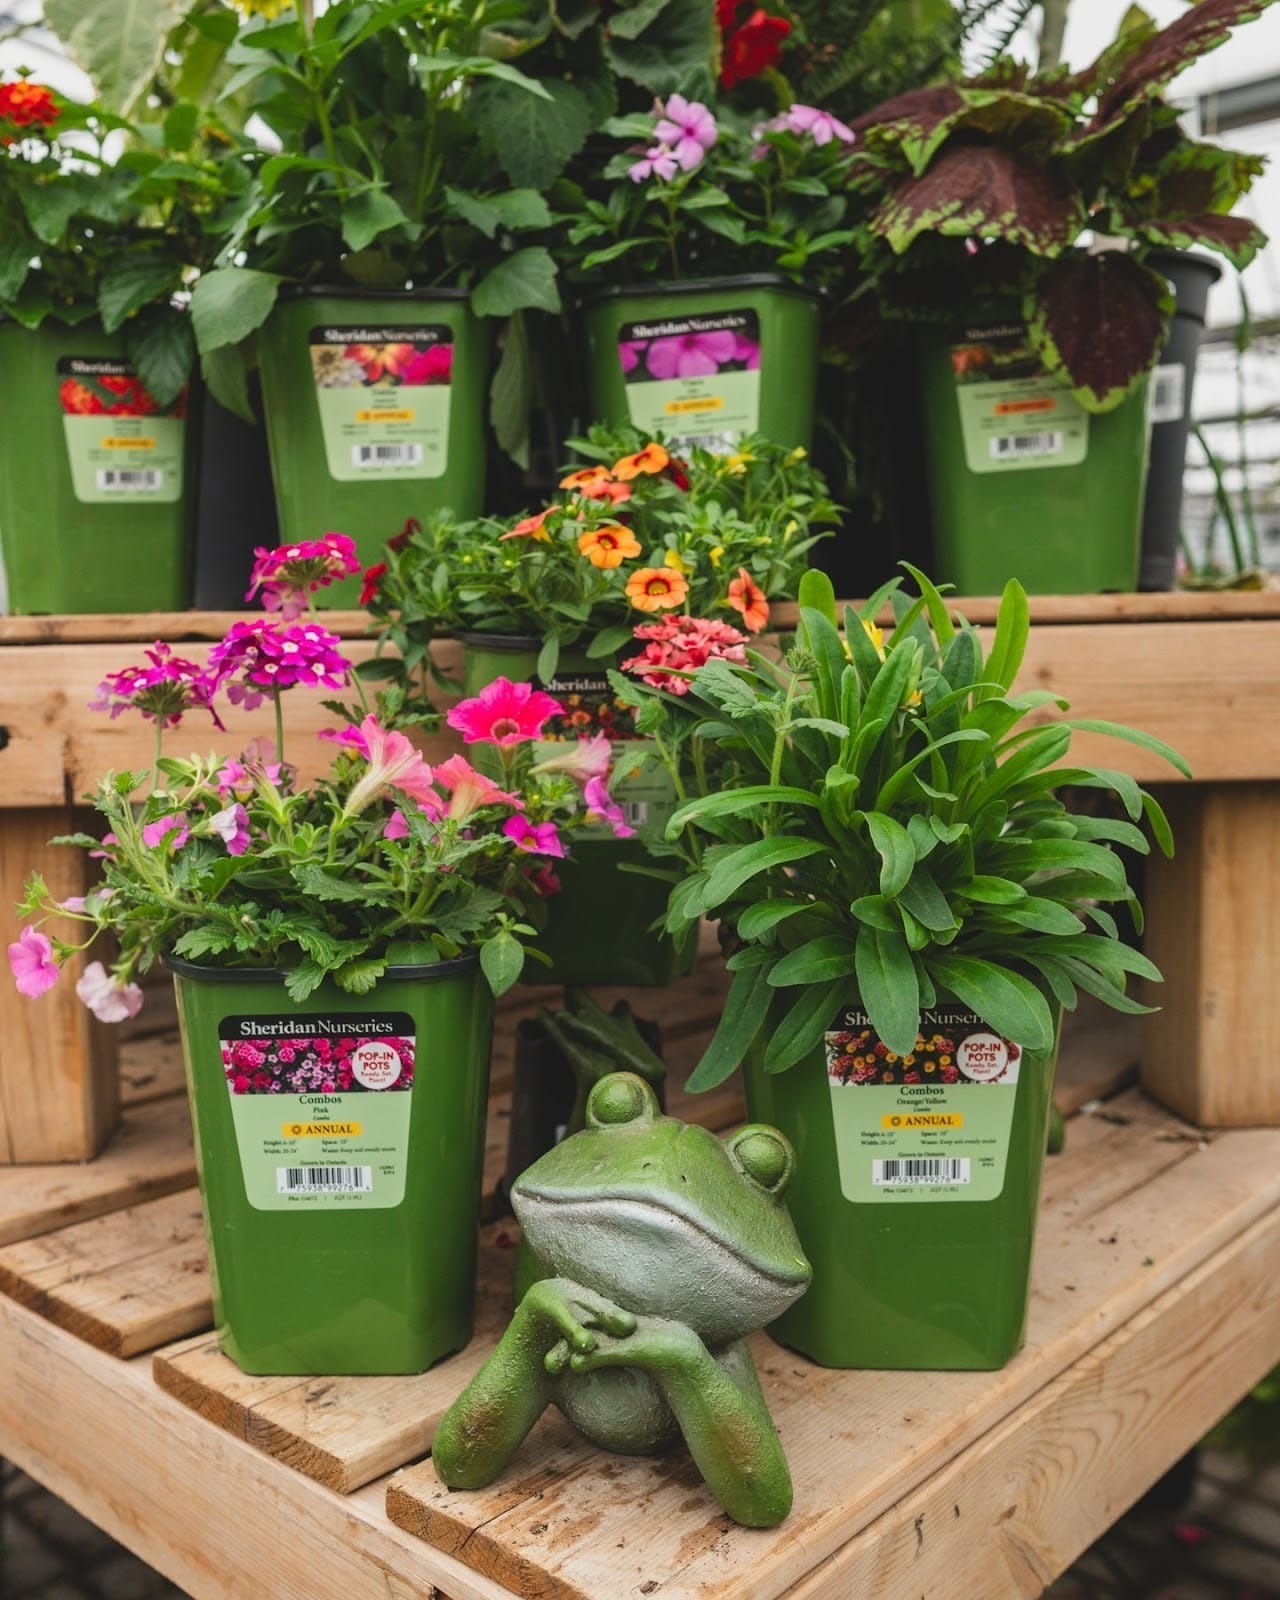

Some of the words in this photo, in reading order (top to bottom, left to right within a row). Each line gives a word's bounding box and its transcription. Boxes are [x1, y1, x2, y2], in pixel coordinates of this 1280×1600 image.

[924, 1011, 985, 1024] Nurseri
[964, 1043, 1001, 1051] POP-IN
[358, 1052, 394, 1061] POP-IN
[968, 1053, 996, 1061] POTS
[363, 1062, 390, 1070] POTS
[900, 1086, 945, 1095] Combos
[299, 1095, 342, 1104] Combos
[905, 1116, 954, 1126] ANNUAL
[305, 1125, 353, 1135] ANNUAL
